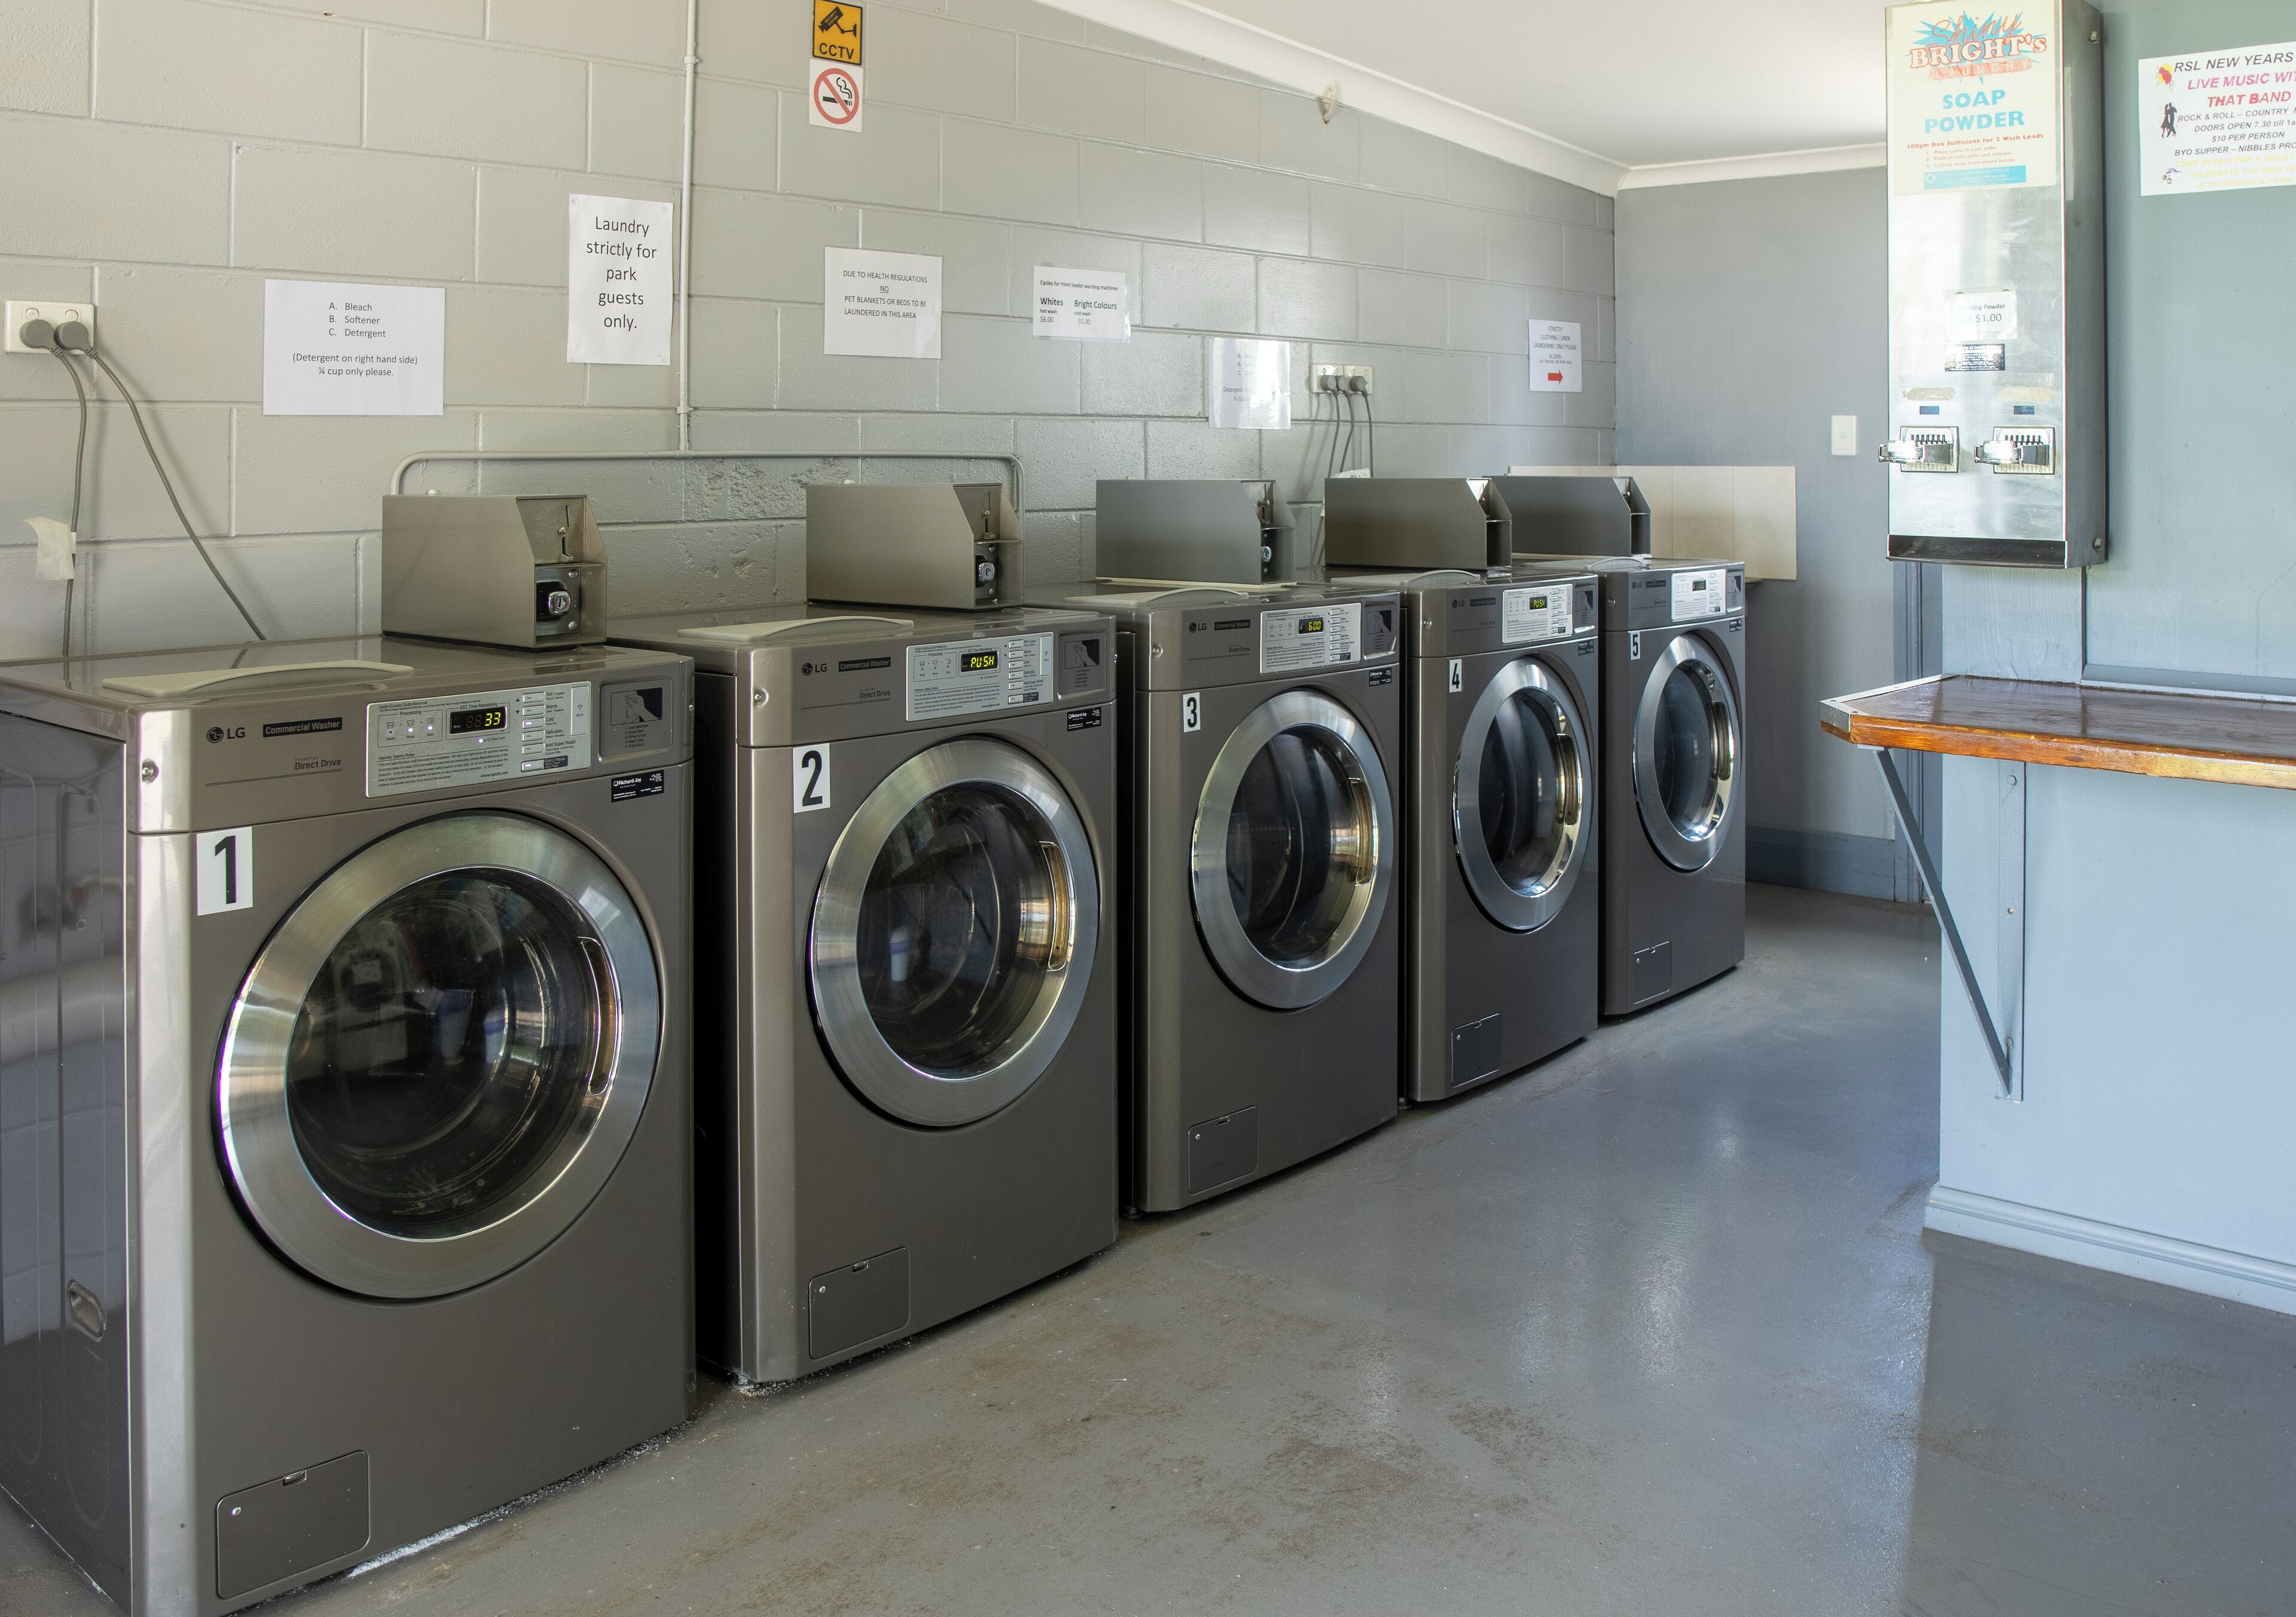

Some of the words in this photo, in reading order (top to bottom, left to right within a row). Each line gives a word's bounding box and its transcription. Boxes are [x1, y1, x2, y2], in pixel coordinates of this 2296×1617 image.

[1926, 14, 2022, 46] Shiny
[819, 43, 854, 59] CCTV
[1935, 60, 2029, 79] LAUNDRY
[2174, 61, 2201, 72] RSL
[2206, 57, 2240, 69] NEW
[2245, 53, 2293, 66] YEARS
[2187, 77, 2219, 90] LIVE
[2223, 73, 2270, 87] MUSIC
[1943, 89, 2005, 109] SOAP
[2208, 94, 2245, 107] THAT
[2249, 91, 2291, 104] BAND
[2245, 108, 2289, 117] COUNTRY
[1925, 111, 2025, 133] POWDER
[2194, 124, 2225, 132] DOORS
[2248, 132, 2285, 140] PERSON
[2195, 146, 2228, 155] SUPPER
[2239, 143, 2276, 152] NIBBLES
[596, 216, 649, 237] Laundry
[587, 242, 632, 259] strictly
[637, 244, 657, 258] for
[606, 267, 637, 282] park
[890, 274, 927, 283] REGULATIONS
[599, 292, 644, 306] guests
[1040, 298, 1064, 306] Whites
[1074, 300, 1092, 309] Bright
[1094, 301, 1117, 310] Colours
[344, 316, 380, 325] Softener
[604, 314, 637, 331] only.
[1976, 313, 2002, 323] $1.00
[344, 329, 386, 338] Detergent
[293, 353, 339, 364] (Detergent
[355, 355, 374, 365] right
[377, 355, 396, 363] hand
[399, 355, 417, 364] side)
[328, 369, 343, 377] cup
[346, 368, 363, 377] only
[366, 368, 394, 377] please.
[1633, 635, 1638, 656] 5
[815, 664, 827, 673] LG
[840, 661, 869, 670] Commercial
[970, 656, 994, 668] PUSH
[1452, 663, 1459, 689] 4
[485, 712, 501, 726] 33
[1187, 697, 1197, 728] 3
[227, 727, 245, 739] LG
[265, 723, 310, 734] Commercial
[312, 721, 340, 730] Washer
[295, 760, 319, 769] Direct
[321, 758, 341, 766] Drive
[802, 750, 822, 806] 2
[215, 836, 236, 904] 1
